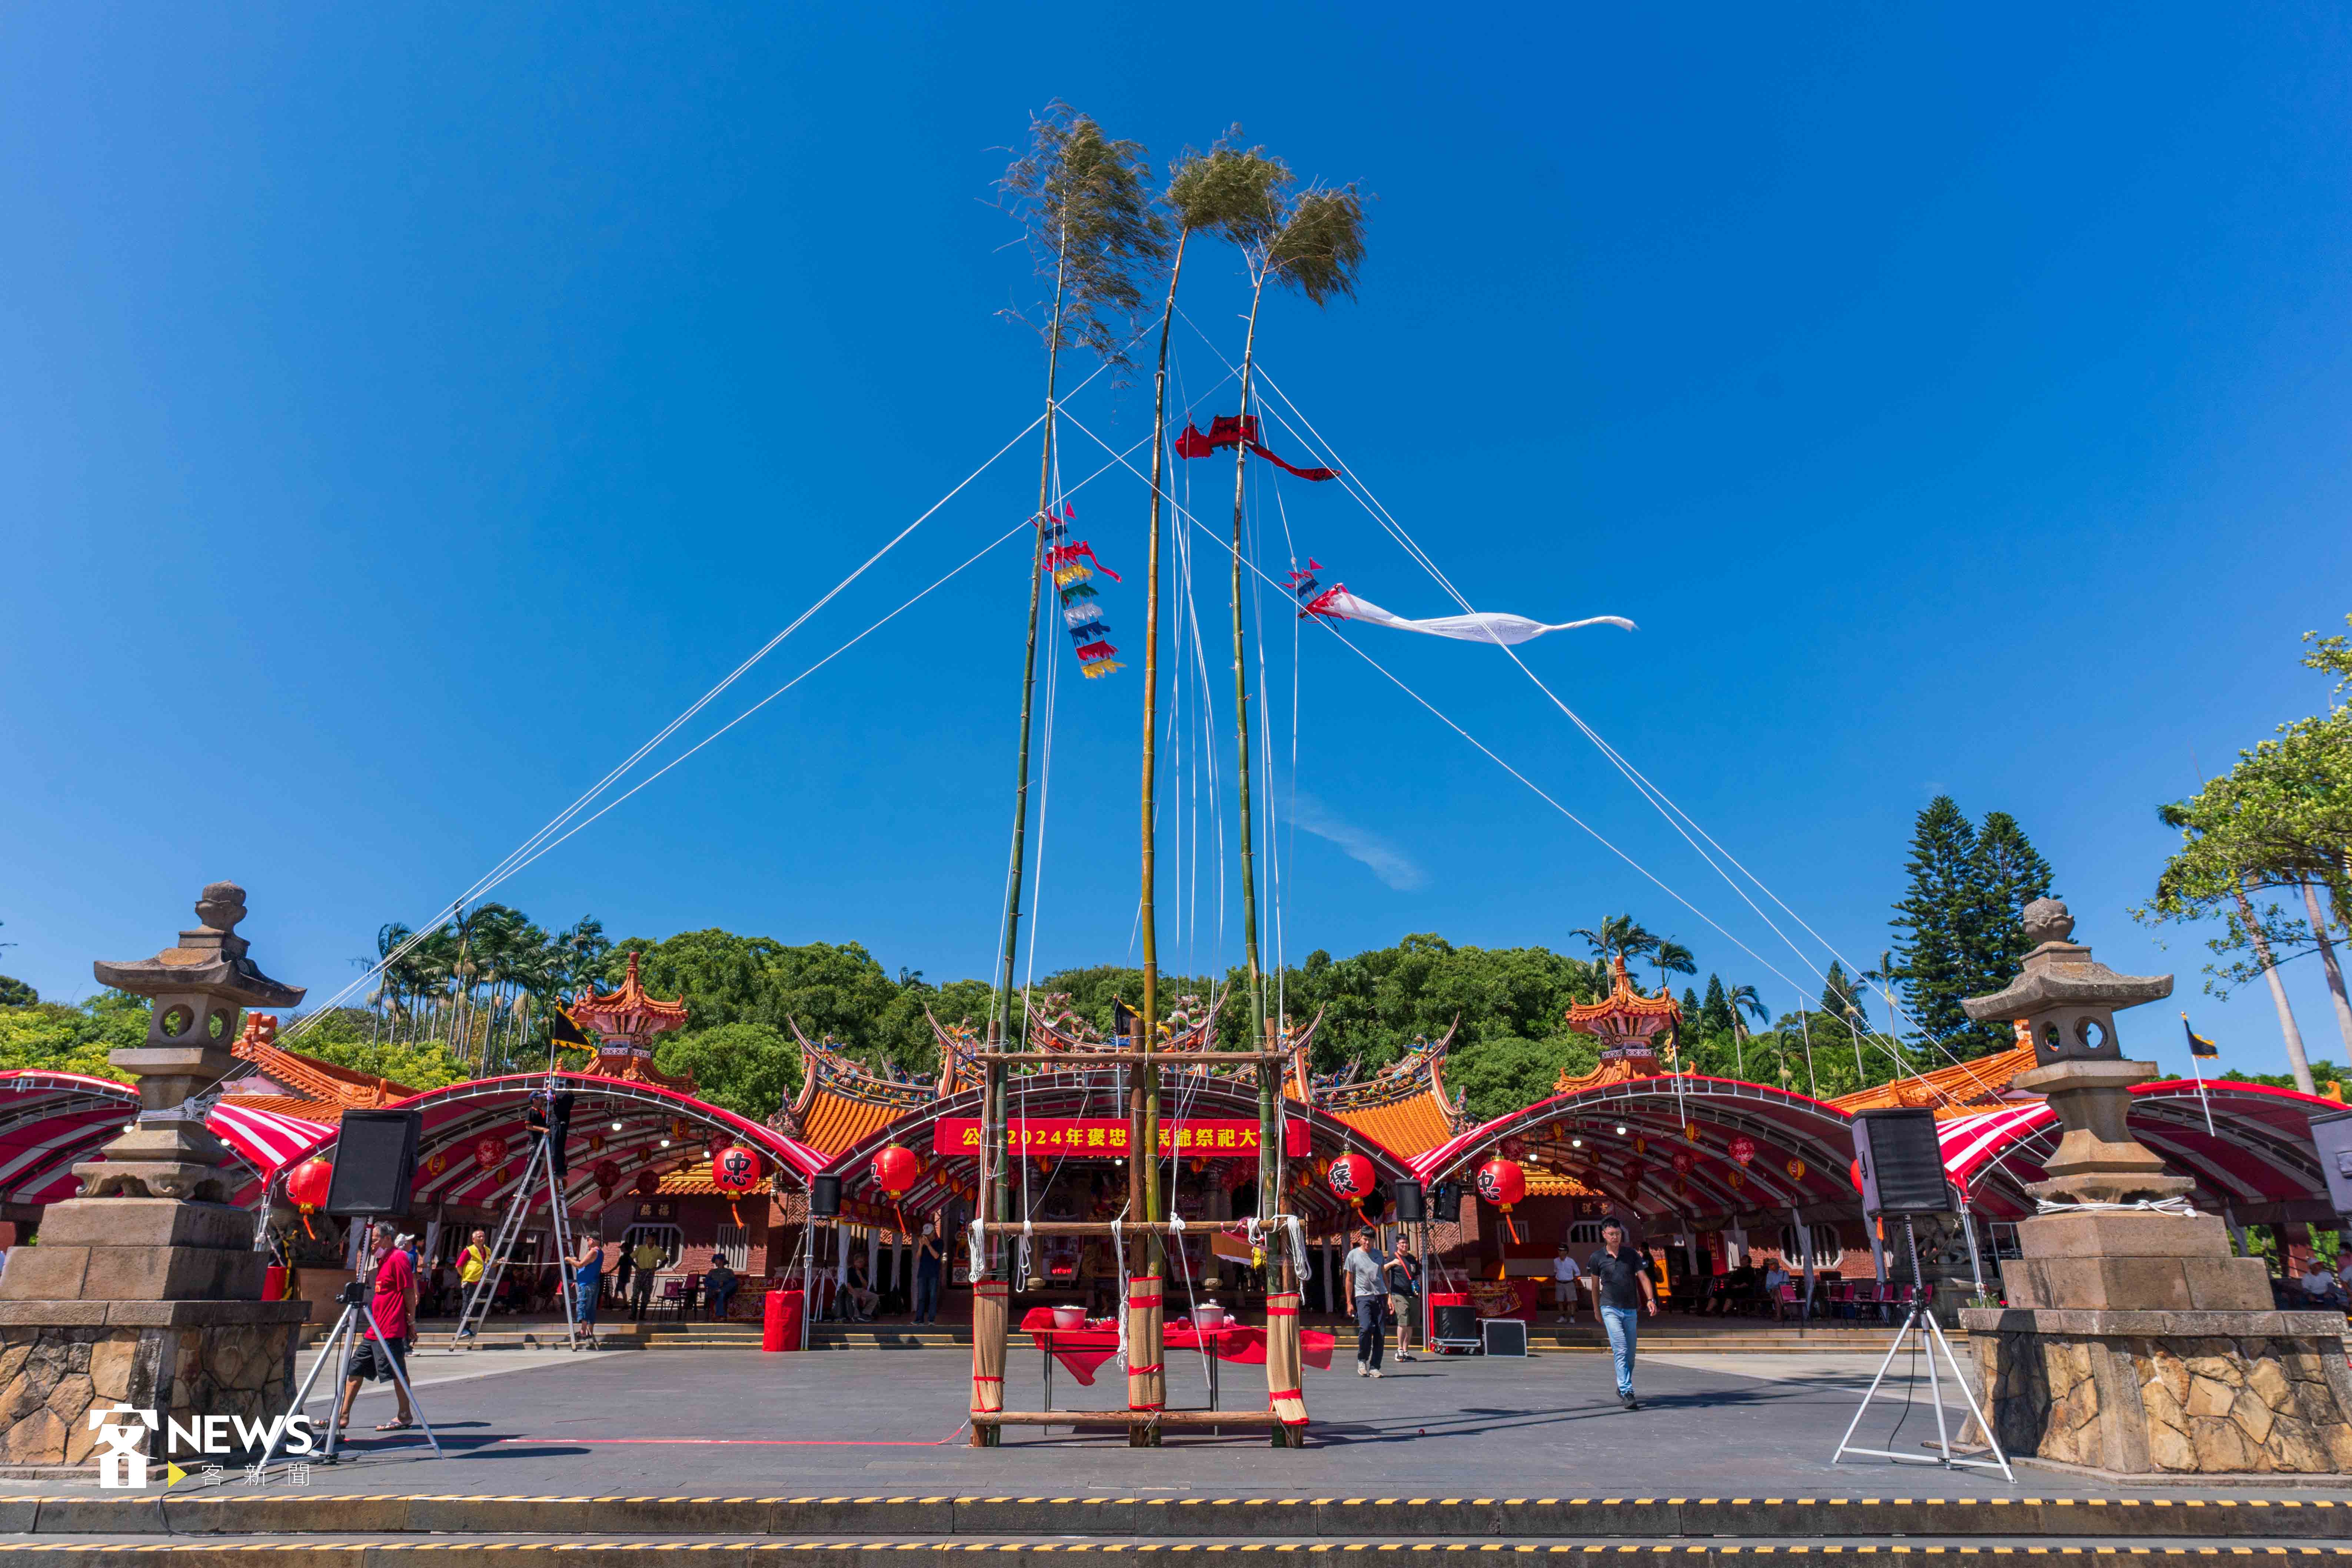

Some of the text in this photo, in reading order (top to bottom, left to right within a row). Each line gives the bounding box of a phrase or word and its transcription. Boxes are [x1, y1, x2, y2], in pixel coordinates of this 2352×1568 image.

[962, 1128, 1257, 1147] 公2024年褒忠民爺祭祀大
[722, 1152, 752, 1186] 忠
[1477, 1169, 1501, 1201] 忠
